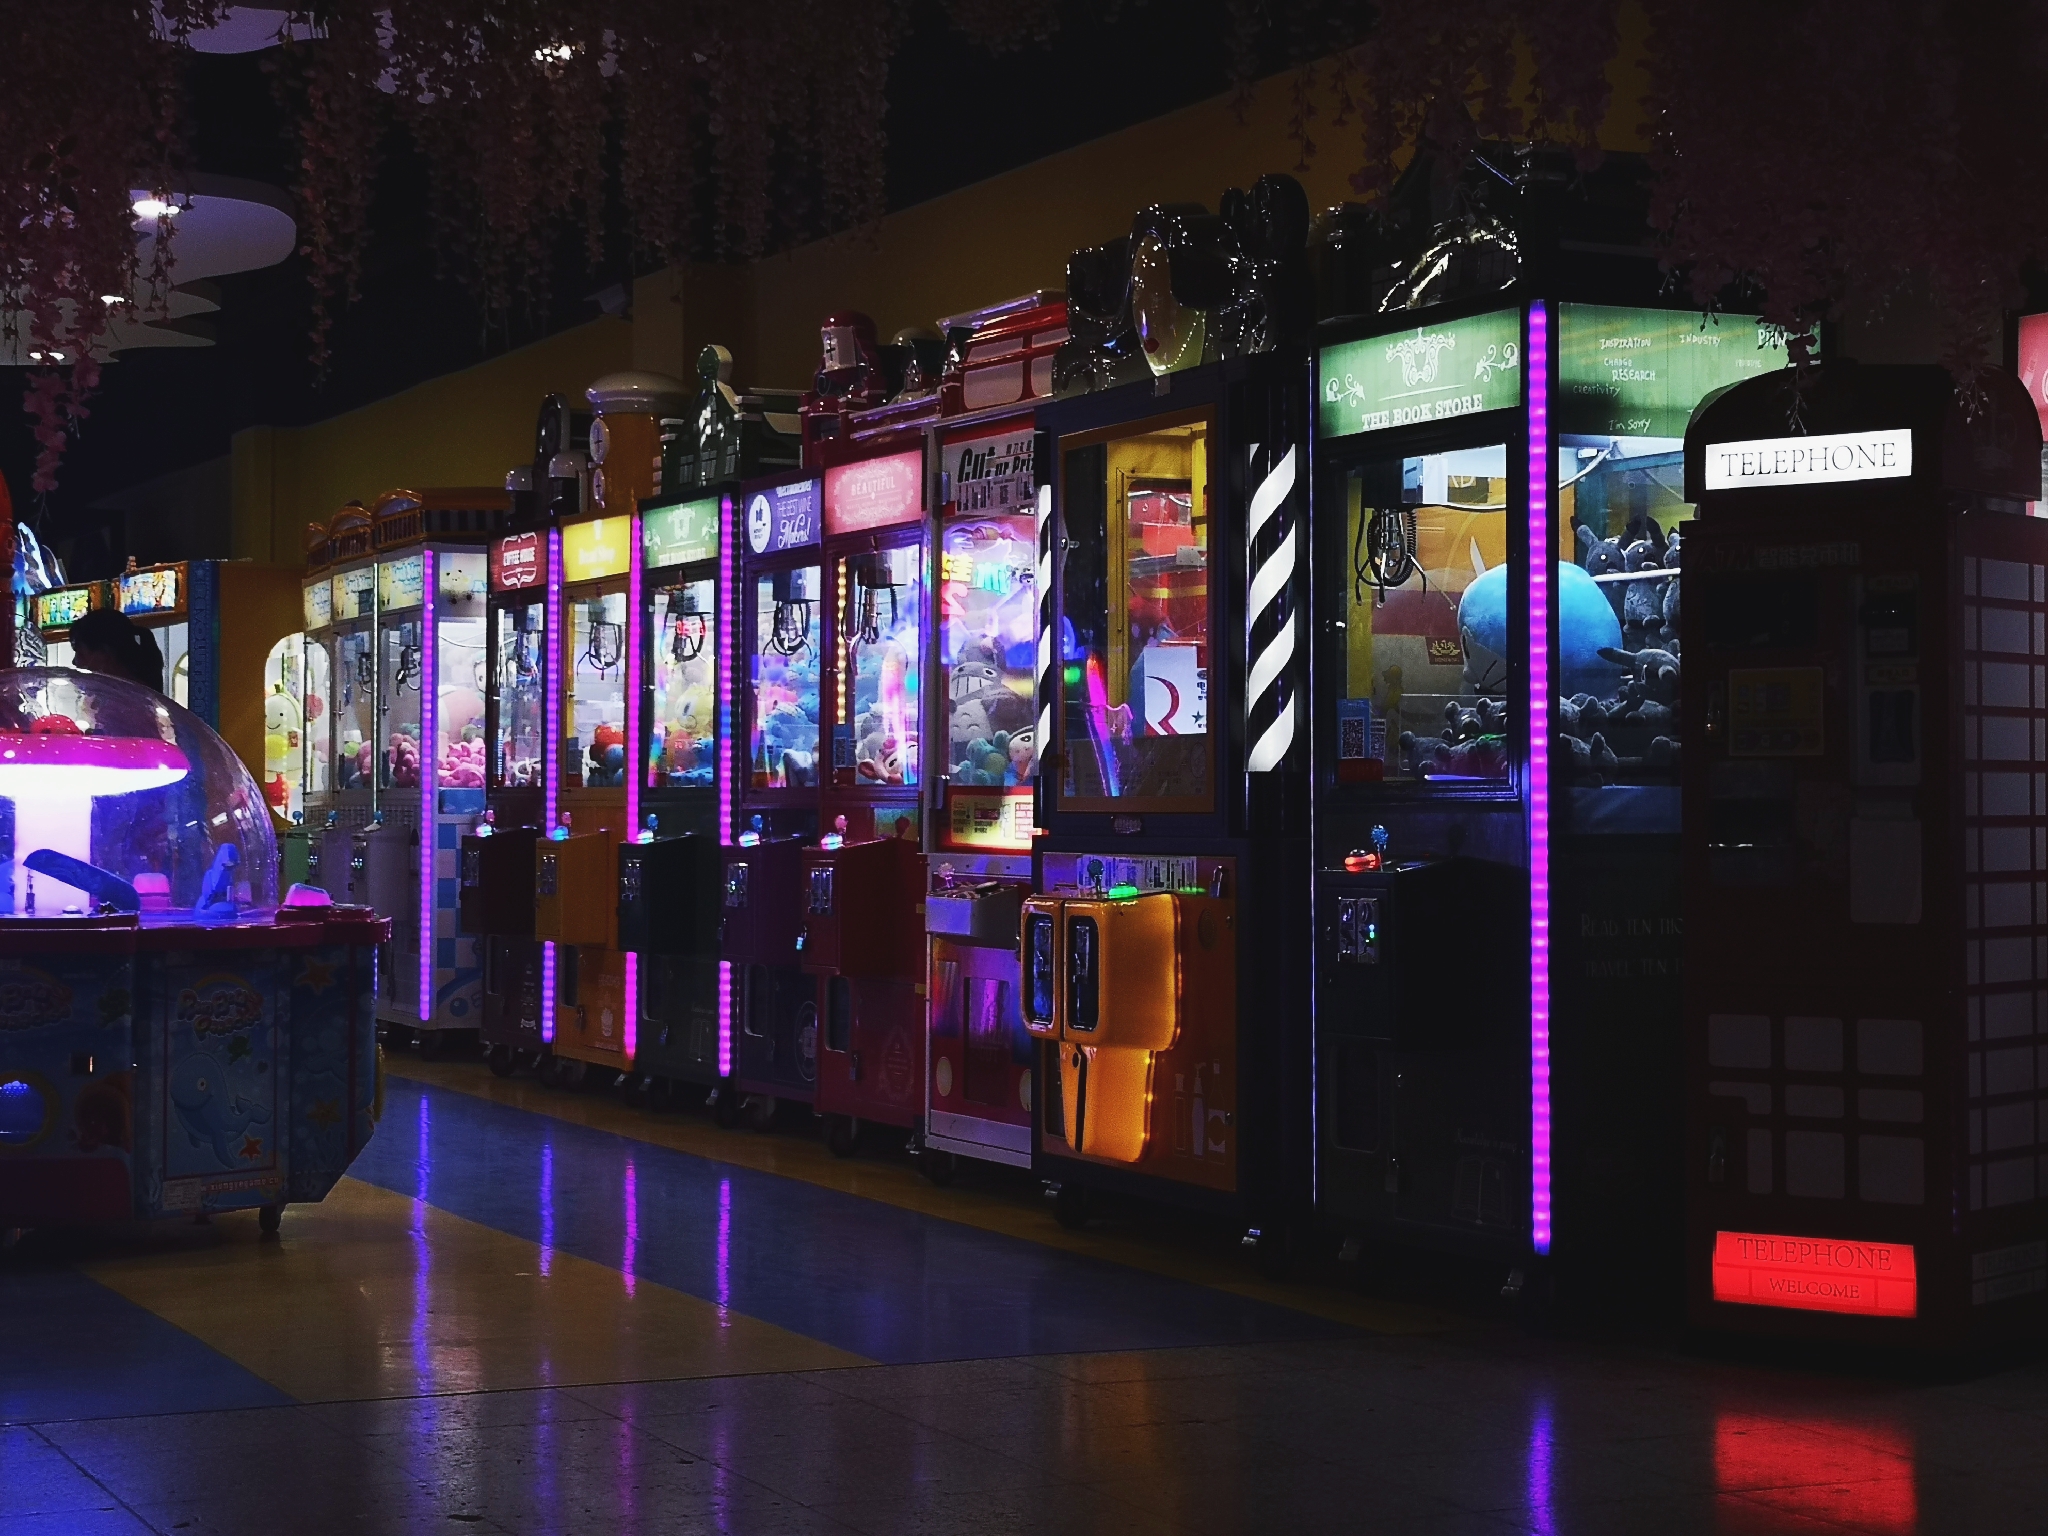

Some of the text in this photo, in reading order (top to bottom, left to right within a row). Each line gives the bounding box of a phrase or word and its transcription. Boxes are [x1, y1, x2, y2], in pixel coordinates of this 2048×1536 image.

[1599, 337, 1652, 350] INSPIRATION
[1679, 333, 1721, 347] INDUSTRY
[1612, 368, 1656, 382] RESEARCH
[1362, 394, 1483, 430] THE BOOK STORE
[1720, 442, 1896, 477] TELEPHONE
[851, 476, 896, 497] BEAUTIFUL
[1737, 1238, 1892, 1271] TELEPHONE
[1768, 1277, 1860, 1299] WELCOME
